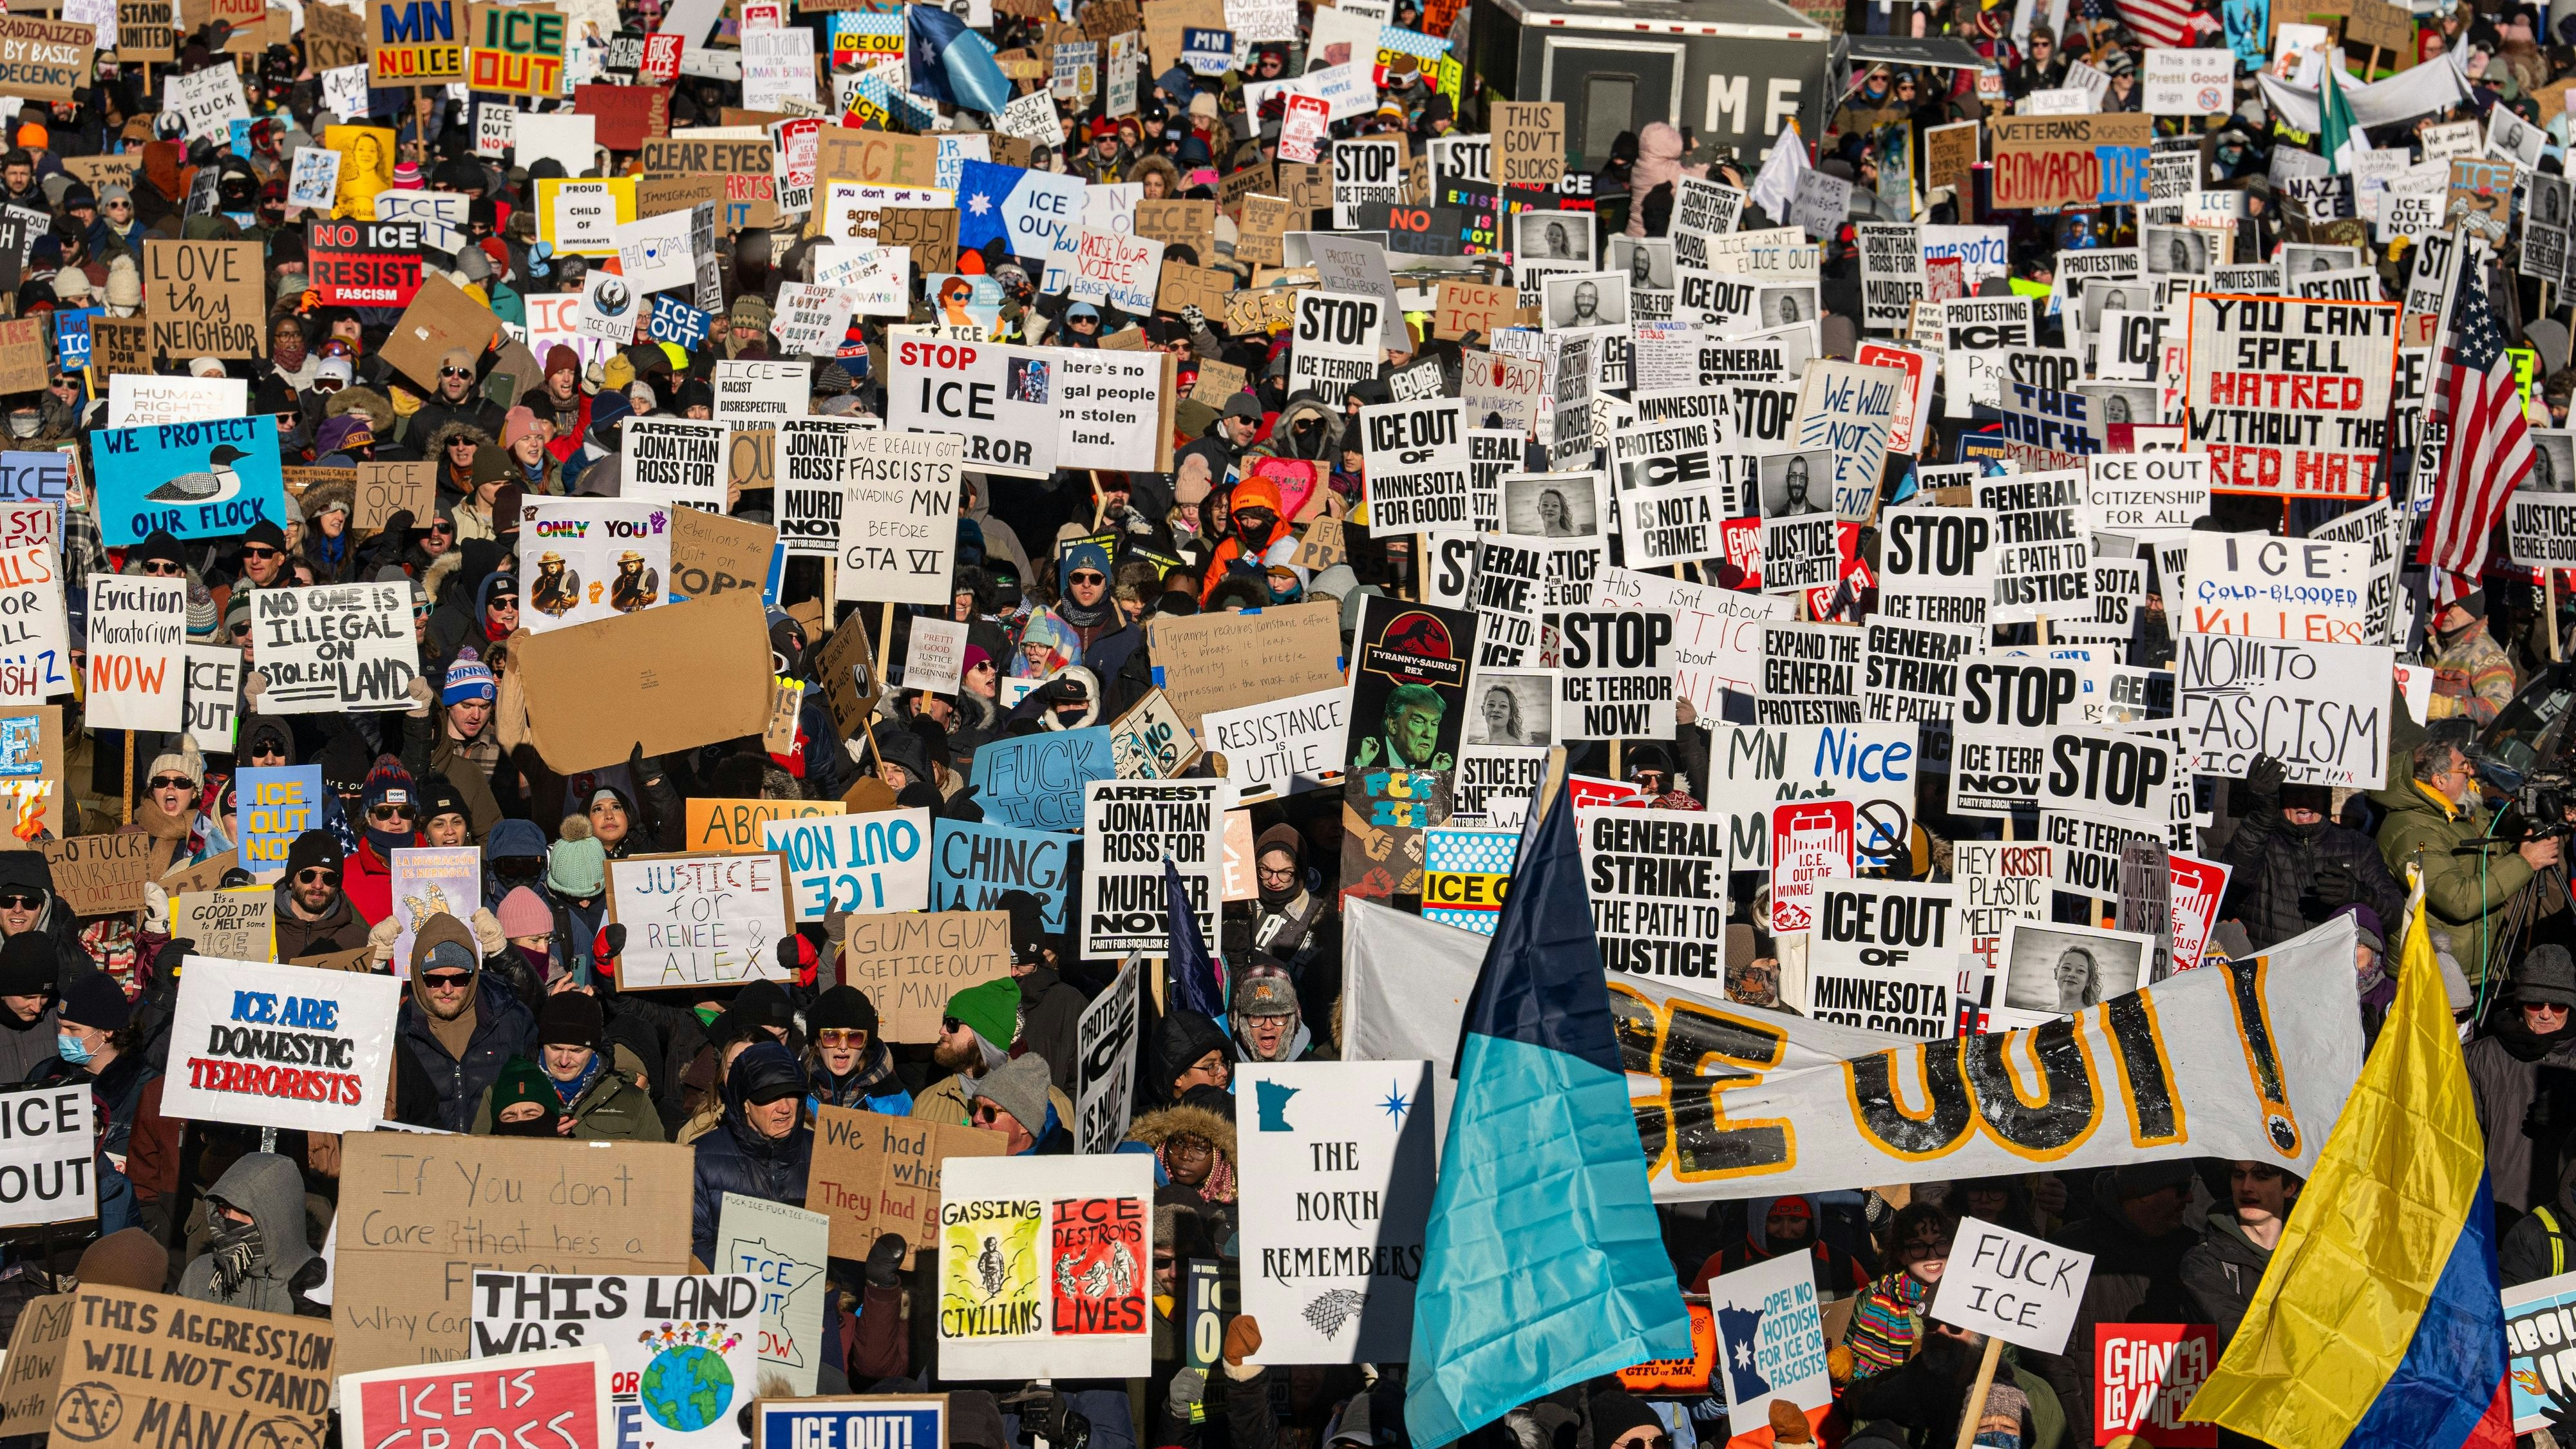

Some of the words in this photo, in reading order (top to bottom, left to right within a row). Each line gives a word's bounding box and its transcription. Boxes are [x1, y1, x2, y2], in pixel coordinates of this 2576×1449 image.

[120, 4, 171, 24] STAND
[381, 1, 454, 43] MN
[120, 28, 171, 48] UNITED
[486, 12, 563, 53] ICE
[5, 40, 27, 61] BY
[31, 44, 80, 66] BASIC
[376, 45, 462, 77] NOICE
[2159, 55, 2184, 66] This
[2192, 56, 2202, 65] is
[471, 50, 560, 93] OUT
[2148, 72, 2186, 84] Pretti
[2191, 72, 2229, 84] Good
[2157, 91, 2183, 103] sign
[484, 108, 513, 119] ICE
[1506, 107, 1552, 128] THIS
[482, 124, 511, 135] OUT
[1504, 130, 1561, 153] GOV'T
[1996, 120, 2090, 140] VETERANS
[2094, 124, 2150, 139] AGAINST
[645, 143, 707, 171] CLEAR
[713, 146, 772, 172] EYES
[1505, 157, 1558, 180] SUCKS
[567, 185, 602, 193] PROUD
[837, 189, 855, 199] you
[862, 189, 884, 198] don't
[895, 192, 910, 201] get
[2391, 212, 2434, 222] OUT
[2396, 198, 2430, 209] ICE
[314, 225, 357, 246] NO
[368, 226, 417, 247] ICE
[1861, 227, 1917, 235] ARREST
[1865, 237, 1917, 254] JONATHAN
[154, 245, 241, 282] LOVE
[313, 261, 419, 287] RESIST
[1869, 255, 1893, 272] ROSS
[1895, 255, 1917, 272] FOR
[166, 283, 232, 326] thy
[336, 289, 397, 301] FASCISM
[1868, 281, 1924, 305] MURDER
[1654, 321, 1687, 330] RADICALIZED
[1947, 303, 2027, 322] PROTESTING
[2210, 299, 2283, 332] YOU
[2304, 307, 2396, 335] CAN'T
[153, 322, 257, 351] NEIGHBOR
[585, 317, 602, 332] ICE
[606, 317, 634, 338] OUT!
[1639, 330, 1665, 340] JESUS
[1949, 325, 2027, 350] ICE
[2238, 337, 2349, 372] SPELL
[2210, 373, 2364, 411] HATRED
[104, 428, 139, 454] WE
[160, 417, 258, 451] PROTECT
[1369, 413, 1408, 452] ICE
[1410, 408, 1459, 447] OUT
[2189, 408, 2324, 444] WITHOUT
[851, 435, 877, 453] WE
[884, 437, 932, 457] REALLY
[936, 442, 960, 457] GOT
[1399, 449, 1435, 464] OF
[849, 457, 951, 482] FASCISTS
[2094, 461, 2138, 481] ICE
[2146, 461, 2202, 480] OUT
[2209, 444, 2280, 488] RED
[2295, 450, 2378, 495] HAT
[1372, 471, 1466, 501] MINNESOTA
[2092, 490, 2206, 507] CITIZENSHIP
[848, 488, 904, 504] INVADING
[911, 489, 950, 517] MN
[1374, 500, 1410, 527] FOR
[1412, 496, 1467, 524] GOOD!
[131, 509, 187, 537] OUR
[200, 498, 267, 528] FLOCK
[536, 520, 591, 538] ONLY
[605, 520, 647, 538] YOU
[869, 521, 929, 538] BEFORE
[2105, 509, 2143, 524] FOR
[2154, 509, 2190, 524] ALL
[848, 547, 898, 571] GTA
[907, 549, 944, 574] VI
[95, 580, 184, 612] Eviction
[260, 592, 299, 618] NO
[308, 589, 365, 612] ONE
[374, 587, 399, 612] IS
[91, 618, 181, 645] Moratorium
[267, 612, 404, 648] ILLEGAL
[923, 633, 953, 644] PRETTI
[1564, 610, 1672, 669] STOP
[316, 639, 355, 661] ON
[918, 652, 953, 664] JUSTICE
[924, 643, 950, 654] GOOD
[1372, 649, 1458, 673] TYRANNY-SAURUS
[91, 654, 166, 694] NOW
[258, 658, 336, 687] STOLEN
[339, 658, 415, 703] LAND
[909, 666, 958, 680] BEGINNING
[1404, 664, 1424, 677] REX
[1562, 678, 1592, 703] ICE
[1597, 676, 1672, 701] TERROR
[1218, 701, 1343, 750] RESISTANCE
[1584, 705, 1651, 735] NOW!
[1276, 742, 1285, 750] IS
[1247, 745, 1321, 782] UTILE
[636, 859, 772, 895] JUSTICE
[192, 905, 238, 920] GOOD
[241, 902, 267, 917] DAY
[213, 893, 227, 904] It's
[666, 894, 733, 922] for
[213, 918, 244, 929] MELT
[648, 922, 728, 948] RENEE
[748, 920, 766, 948] &
[201, 933, 249, 957] ICE
[660, 948, 766, 985] ALEX
[231, 990, 278, 1023] ICE
[278, 996, 339, 1031] ARE
[207, 1025, 354, 1068] DOMESTIC
[1843, 957, 2304, 1161] OUT!
[188, 1057, 361, 1106] TERRORISTS
[1310, 1141, 1359, 1171] THE
[942, 1199, 1042, 1225] GASSING
[1053, 1196, 1142, 1222] ICE
[1296, 1191, 1379, 1229] NORTH
[1052, 1220, 1142, 1248] DESTROYS
[1262, 1244, 1425, 1287] REMEMBERS
[1972, 1233, 2079, 1298] FUCK
[1764, 1288, 1793, 1316] OPE!
[1794, 1282, 1813, 1305] NO
[1964, 1283, 2043, 1331] ICE
[942, 1302, 1043, 1338] CIVILIANS
[1052, 1295, 1144, 1333] LIVES
[1762, 1304, 1819, 1345] HOTDISH
[81, 1294, 158, 1333] THIS
[167, 1308, 334, 1372] AGGRESSION
[1757, 1345, 1782, 1371] FOR
[1784, 1336, 1803, 1360] ICE
[1806, 1329, 1823, 1351] OR
[82, 1340, 154, 1381] WILL
[161, 1352, 225, 1390] NOT
[228, 1365, 328, 1414] STAND
[1770, 1350, 1827, 1390] FASCISTS!
